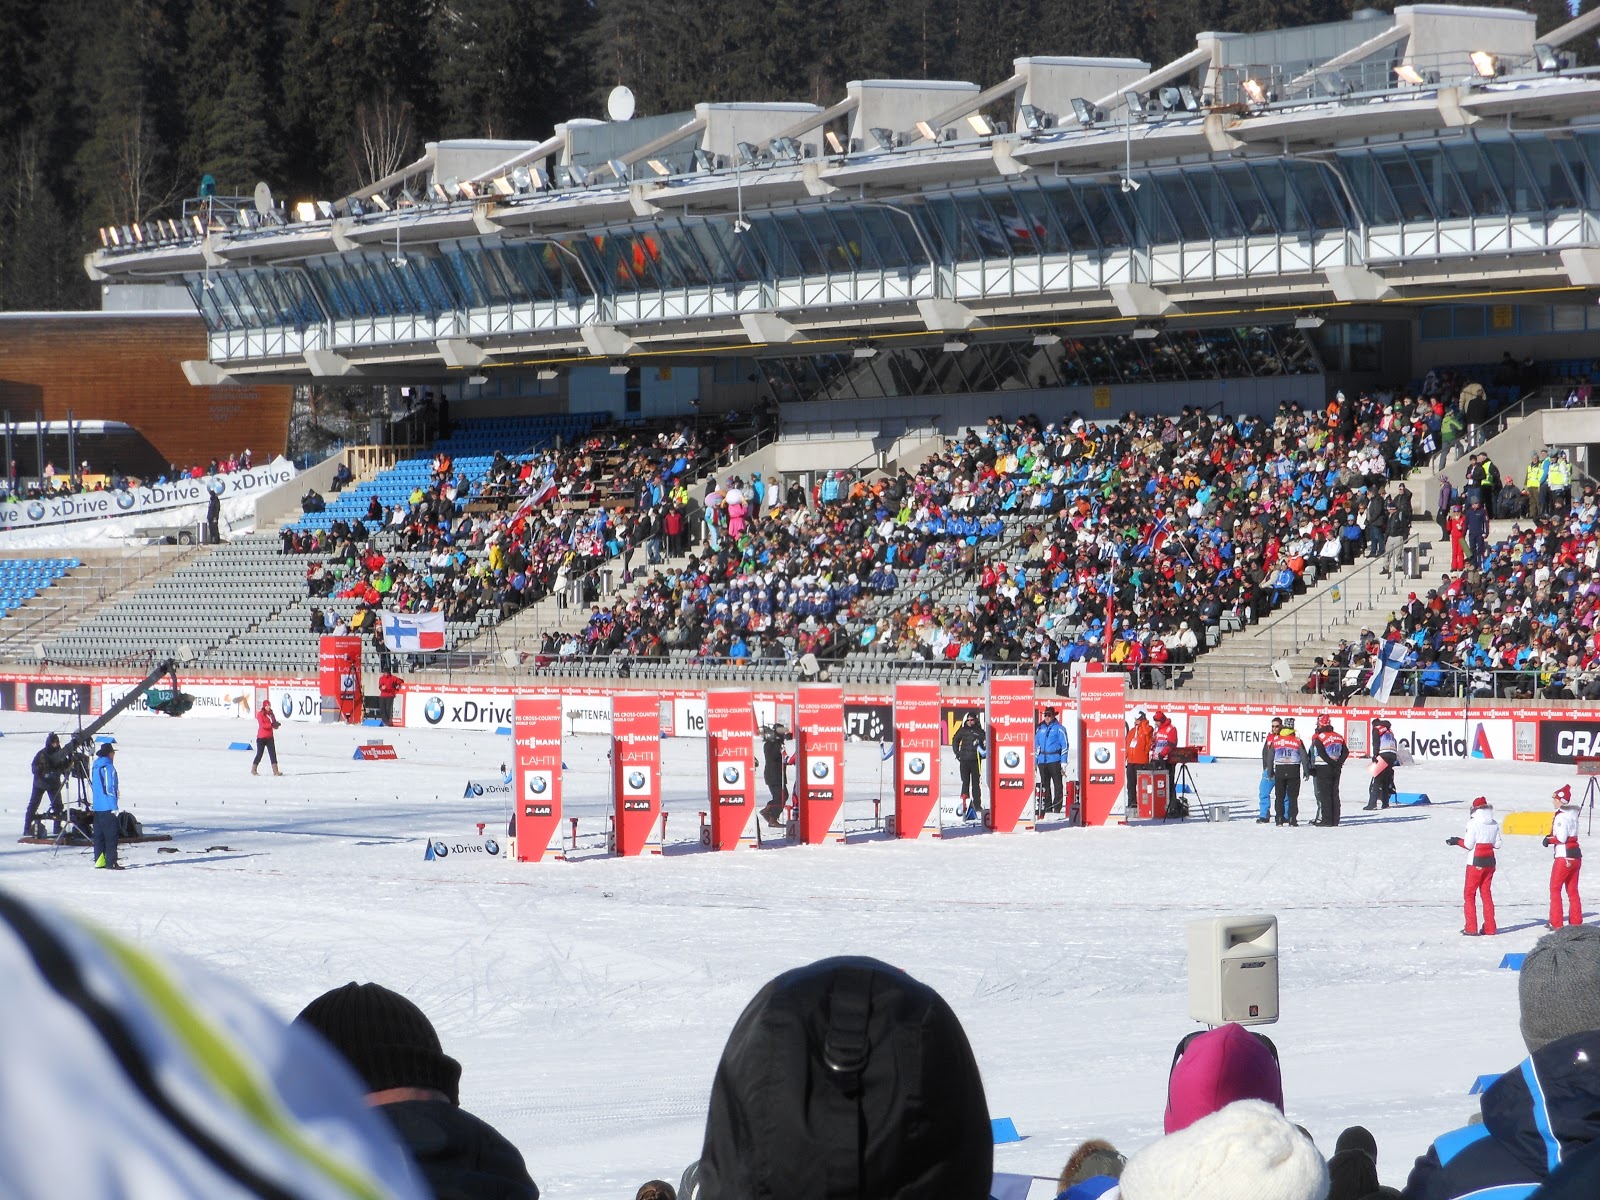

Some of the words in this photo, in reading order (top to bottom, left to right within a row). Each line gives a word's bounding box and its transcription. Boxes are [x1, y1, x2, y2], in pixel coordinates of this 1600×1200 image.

[232, 470, 290, 491] xDrive
[142, 487, 199, 505] xDrive
[52, 499, 108, 517] xDrive
[35, 688, 72, 707] CRAFT
[195, 697, 221, 706] TENFALL
[299, 695, 321, 715] xDri
[1081, 711, 1124, 722] VIESSMANN
[1213, 704, 1237, 713] VIESSMANN
[1345, 707, 1370, 717] VIESSMANN
[1399, 708, 1425, 718] VIESSMANN
[1427, 709, 1451, 718] VIESSMANN
[1483, 709, 1509, 718] VIESSMANN
[1513, 709, 1537, 718] VIESSMANN
[1540, 709, 1563, 719] VIESSMANN
[1565, 710, 1592, 719] VIESSMANN
[896, 720, 939, 732] VIESSMANN
[991, 715, 1033, 726] VIESSMANN
[709, 729, 752, 740] VIESSMANN
[800, 724, 842, 735] VIESSMANN
[1086, 728, 1119, 737] LAHTI
[614, 733, 659, 745] VIESSMANN
[996, 733, 1028, 742] LAHTI
[1220, 730, 1266, 743] VATTENF
[515, 737, 560, 749] VIESSMANN
[805, 743, 838, 751] LAHTI
[901, 739, 934, 748] LAHTI
[1399, 731, 1467, 757] elvetia
[362, 748, 394, 758] VIESSMANN
[620, 752, 654, 761] LAHTI
[714, 747, 748, 757] LAHTI
[521, 756, 555, 766] LAHTI
[486, 783, 510, 794] xDrive
[1072, 808, 1080, 822] 7
[788, 826, 796, 839] 4
[888, 818, 895, 835] 5
[703, 829, 711, 845] 3
[451, 844, 482, 854] xDrive
[510, 841, 515, 857] 1
